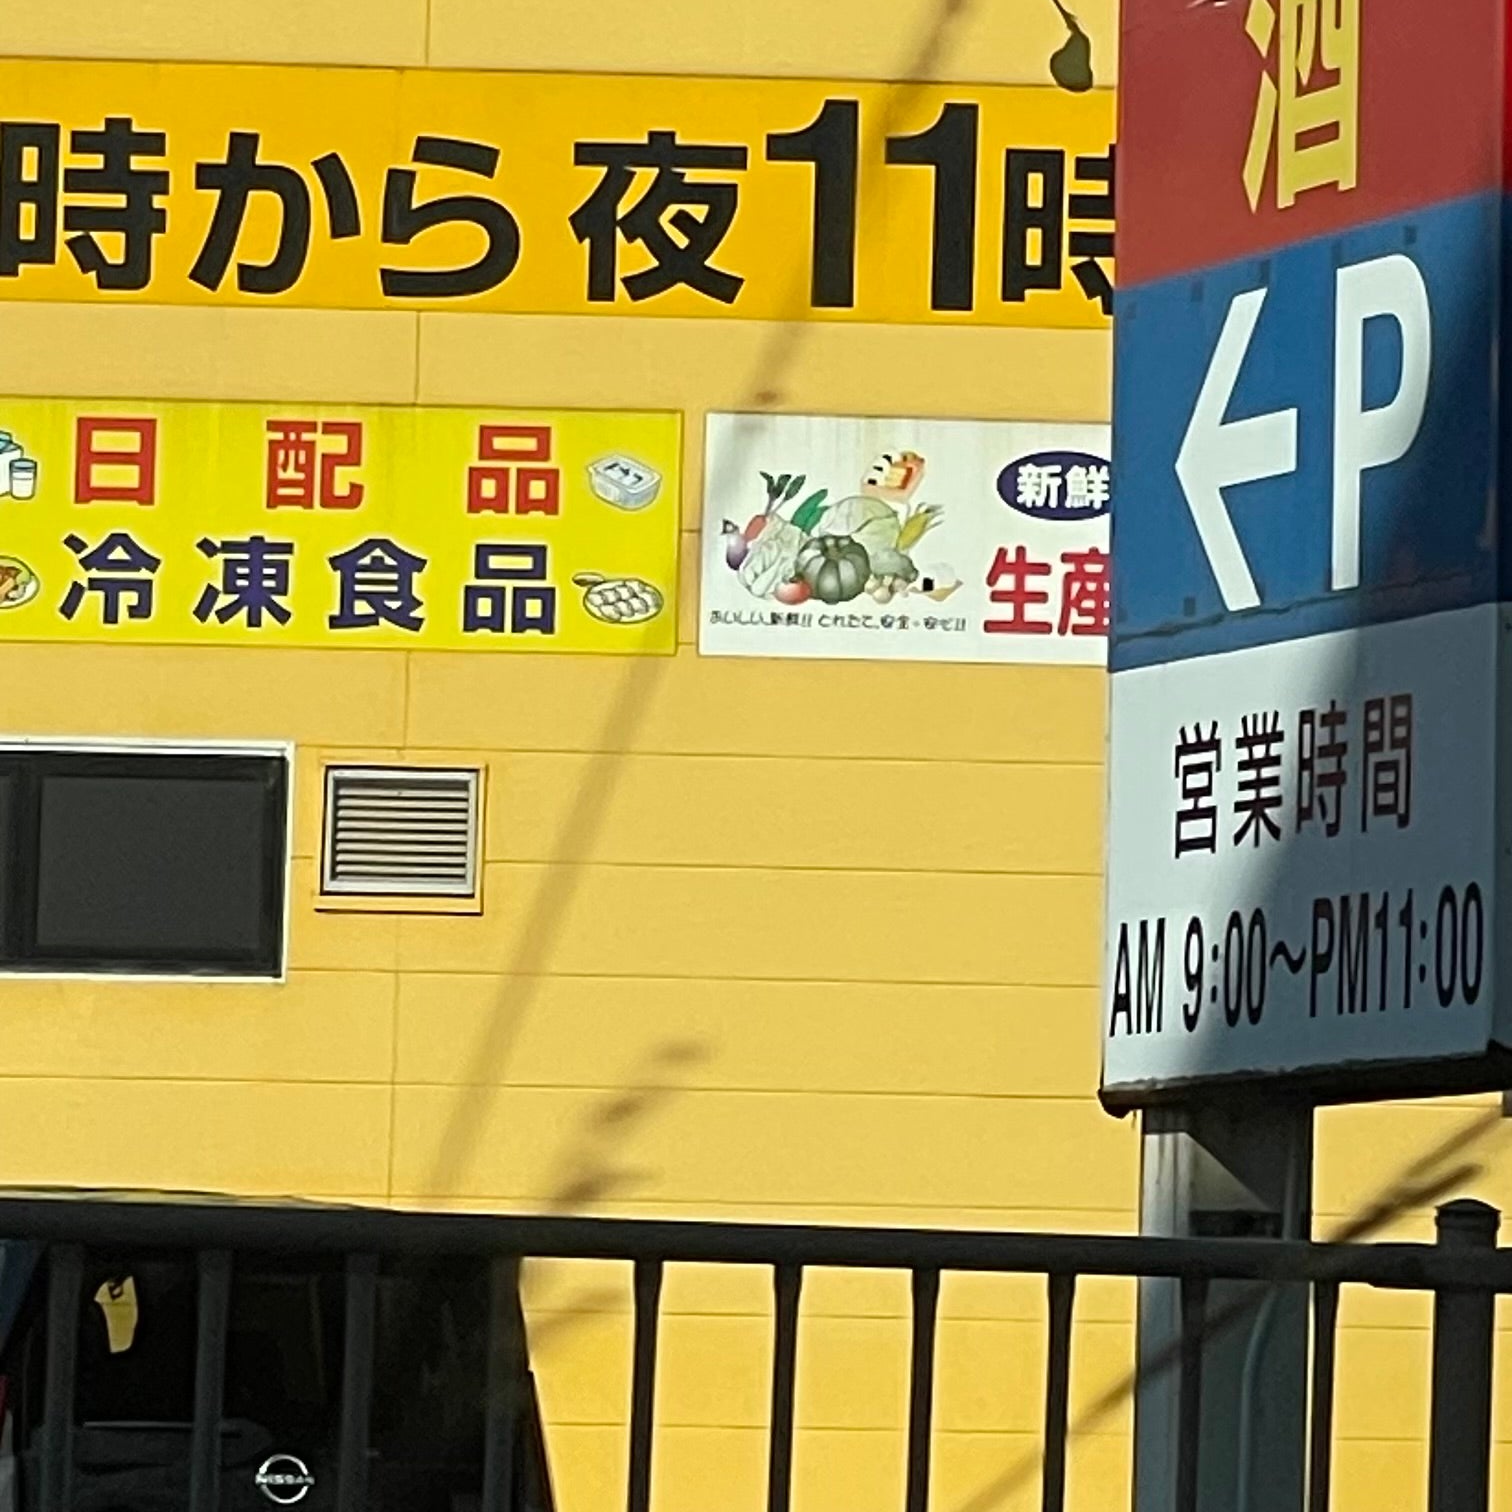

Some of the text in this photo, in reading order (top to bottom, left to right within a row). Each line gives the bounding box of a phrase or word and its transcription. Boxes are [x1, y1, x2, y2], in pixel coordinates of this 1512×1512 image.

[1331, 253, 1433, 592] P
[1017, 462, 1110, 510] 新鮮
[58, 531, 558, 636] 冷凍食品
[984, 544, 1111, 637] 生産
[1174, 693, 1413, 859] 営業時間
